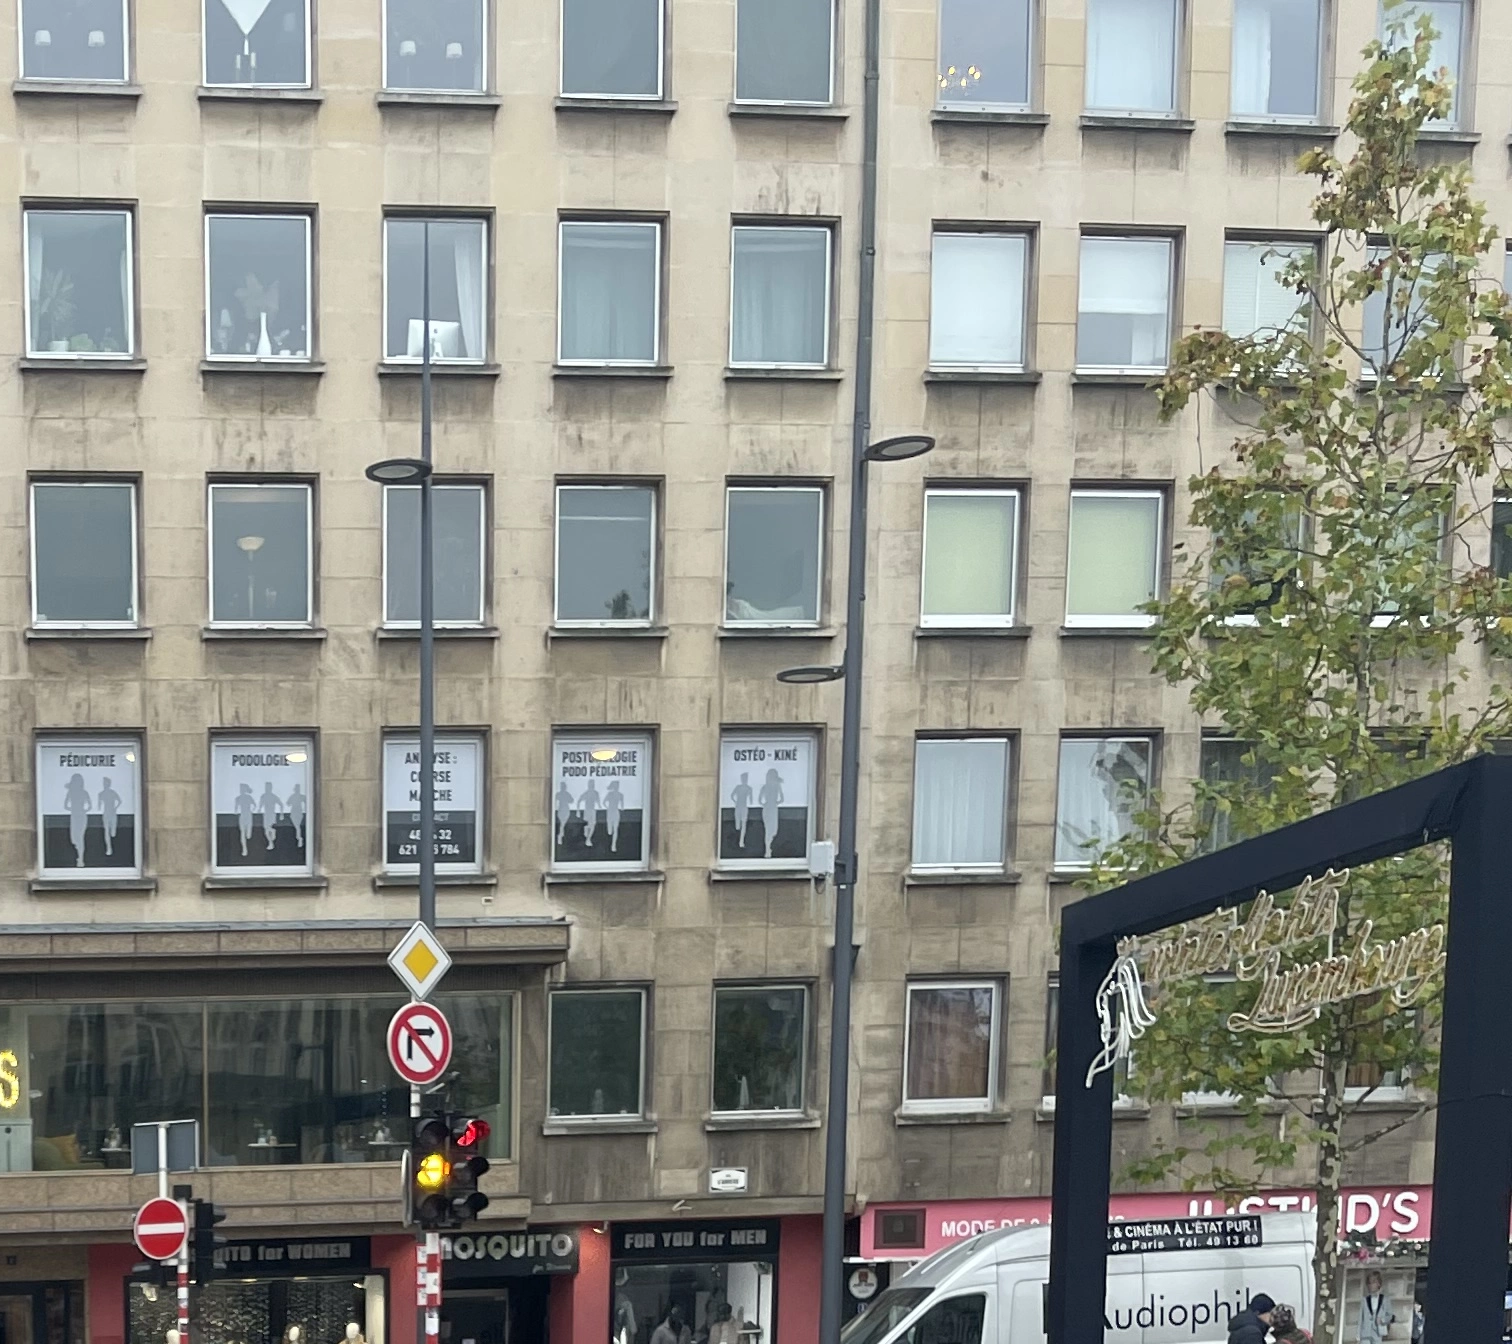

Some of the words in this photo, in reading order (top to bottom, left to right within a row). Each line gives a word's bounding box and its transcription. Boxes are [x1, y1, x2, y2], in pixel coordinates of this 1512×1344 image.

[59, 752, 116, 767] PÉDICURIE
[232, 754, 289, 766] PODOLOGIE
[734, 749, 765, 761] OSTÉO
[774, 748, 797, 761] KINÉ
[562, 767, 587, 777] PODO
[589, 764, 637, 777] PÉDIATRIE
[1125, 1222, 1171, 1236] CINÉMA
[1174, 1221, 1183, 1234] À
[1186, 1220, 1223, 1234] L'ÉTAT
[1226, 1220, 1251, 1232] PUR
[624, 1233, 656, 1249] FOR
[661, 1231, 694, 1248] YOU
[699, 1231, 726, 1247] for
[731, 1229, 767, 1245] MEN
[1111, 1240, 1128, 1251] de
[1132, 1239, 1165, 1250] Paris
[1226, 1236, 1239, 1246] 13
[258, 1246, 284, 1261] for
[287, 1243, 351, 1260] WOMEN
